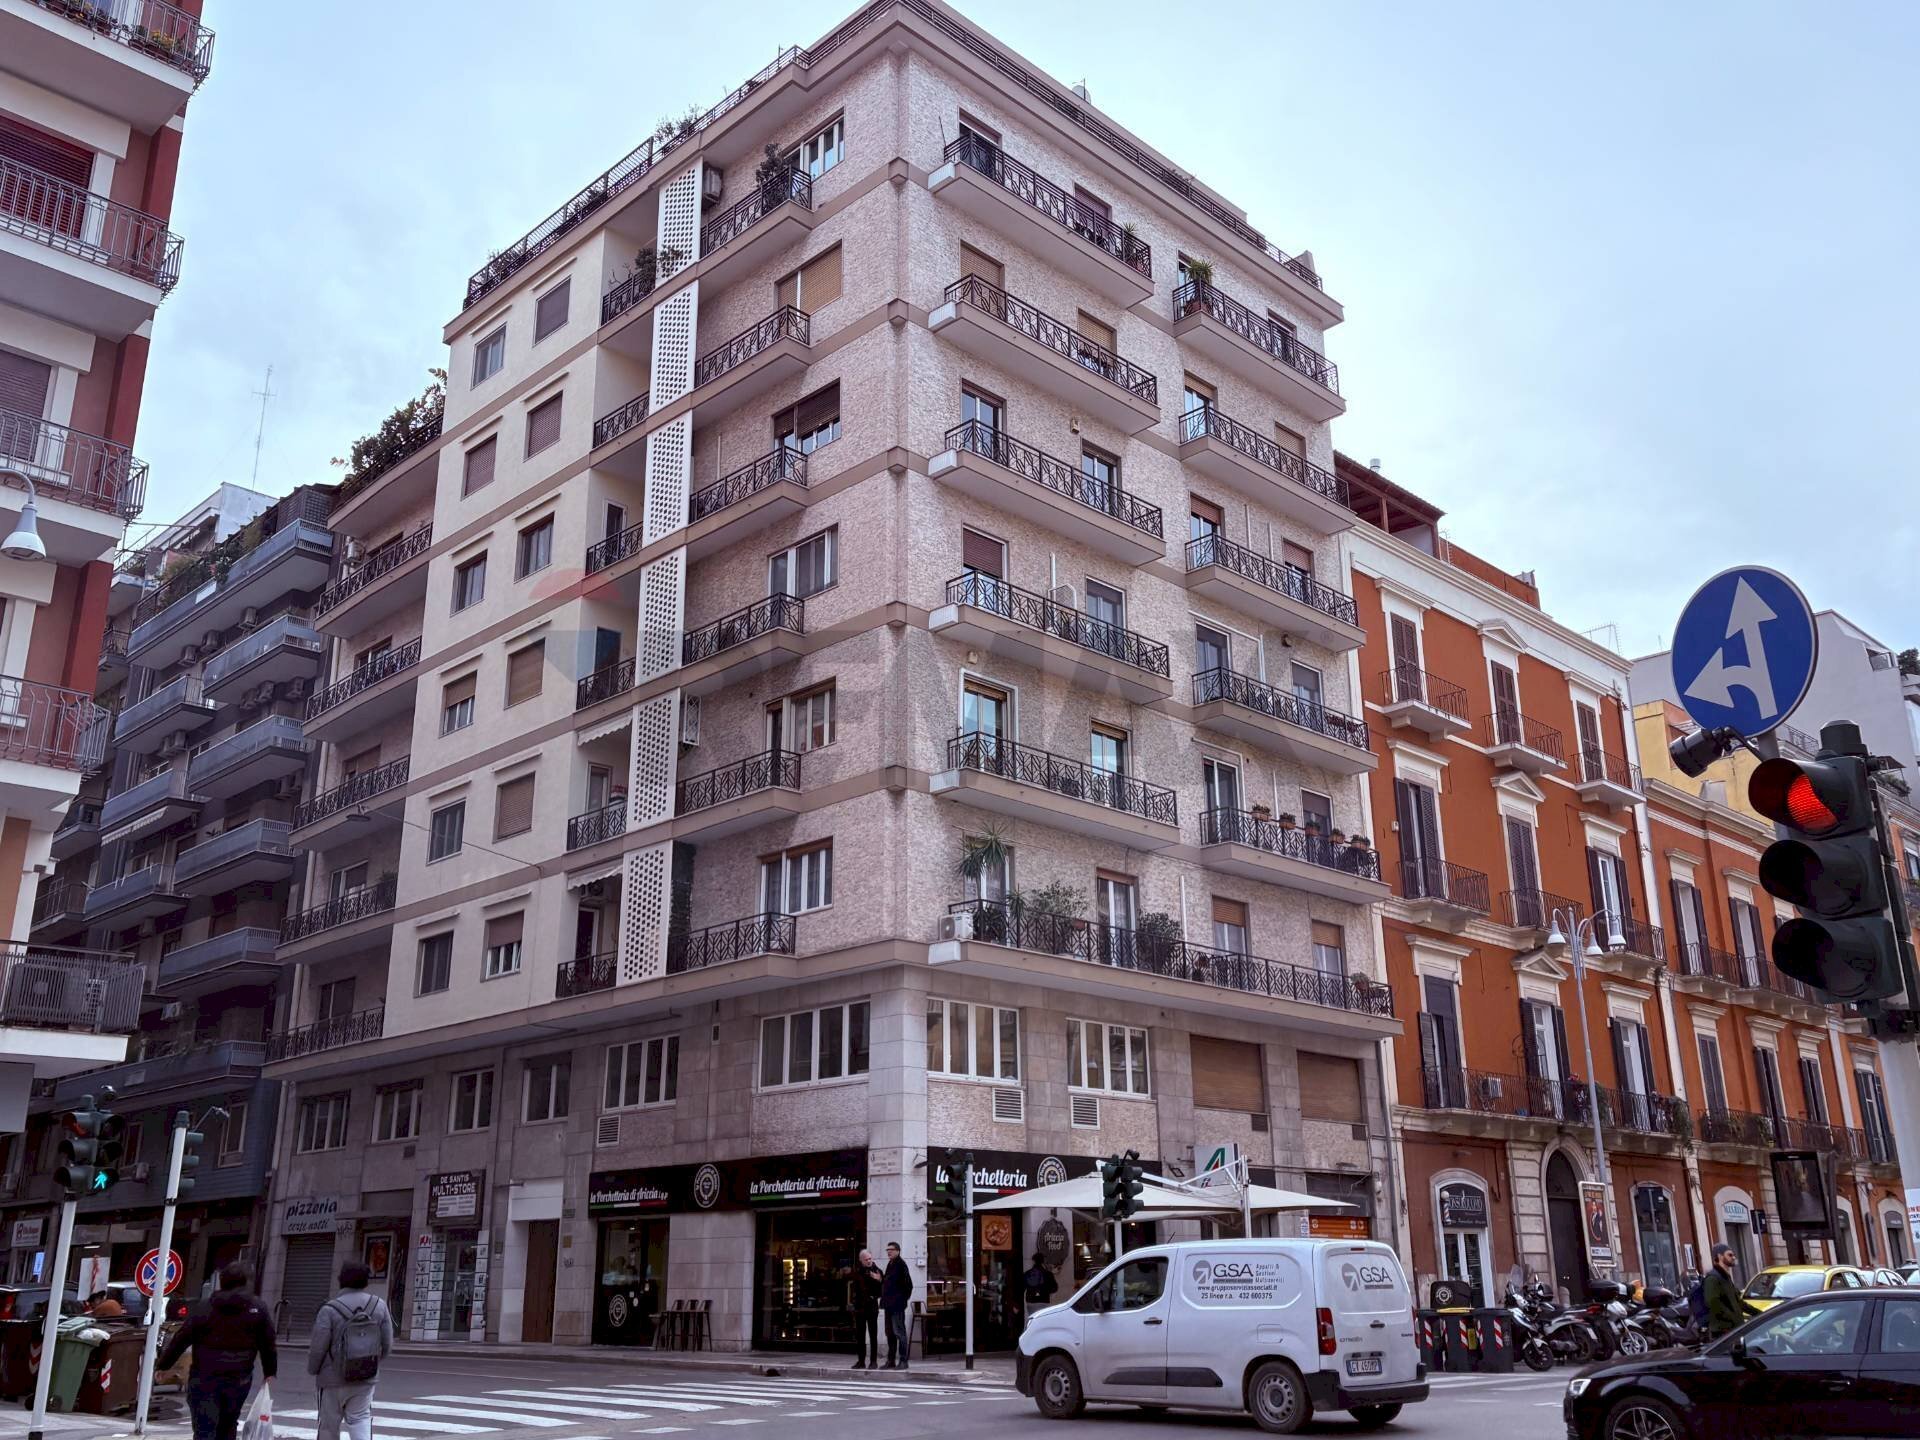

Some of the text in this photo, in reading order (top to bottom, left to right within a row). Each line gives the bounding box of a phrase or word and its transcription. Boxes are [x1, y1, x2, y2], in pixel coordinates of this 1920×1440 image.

[440, 1174, 470, 1184] DE SANTIS
[935, 1165, 950, 1184] la
[432, 1182, 476, 1197] MULTI-STORE
[759, 1178, 805, 1193] Porchetteria
[806, 1177, 816, 1190] di
[816, 1175, 846, 1191] Ariccia
[286, 1198, 337, 1220] pizzeria
[1213, 1263, 1254, 1278] GSA
[1360, 1266, 1392, 1283] GSA
